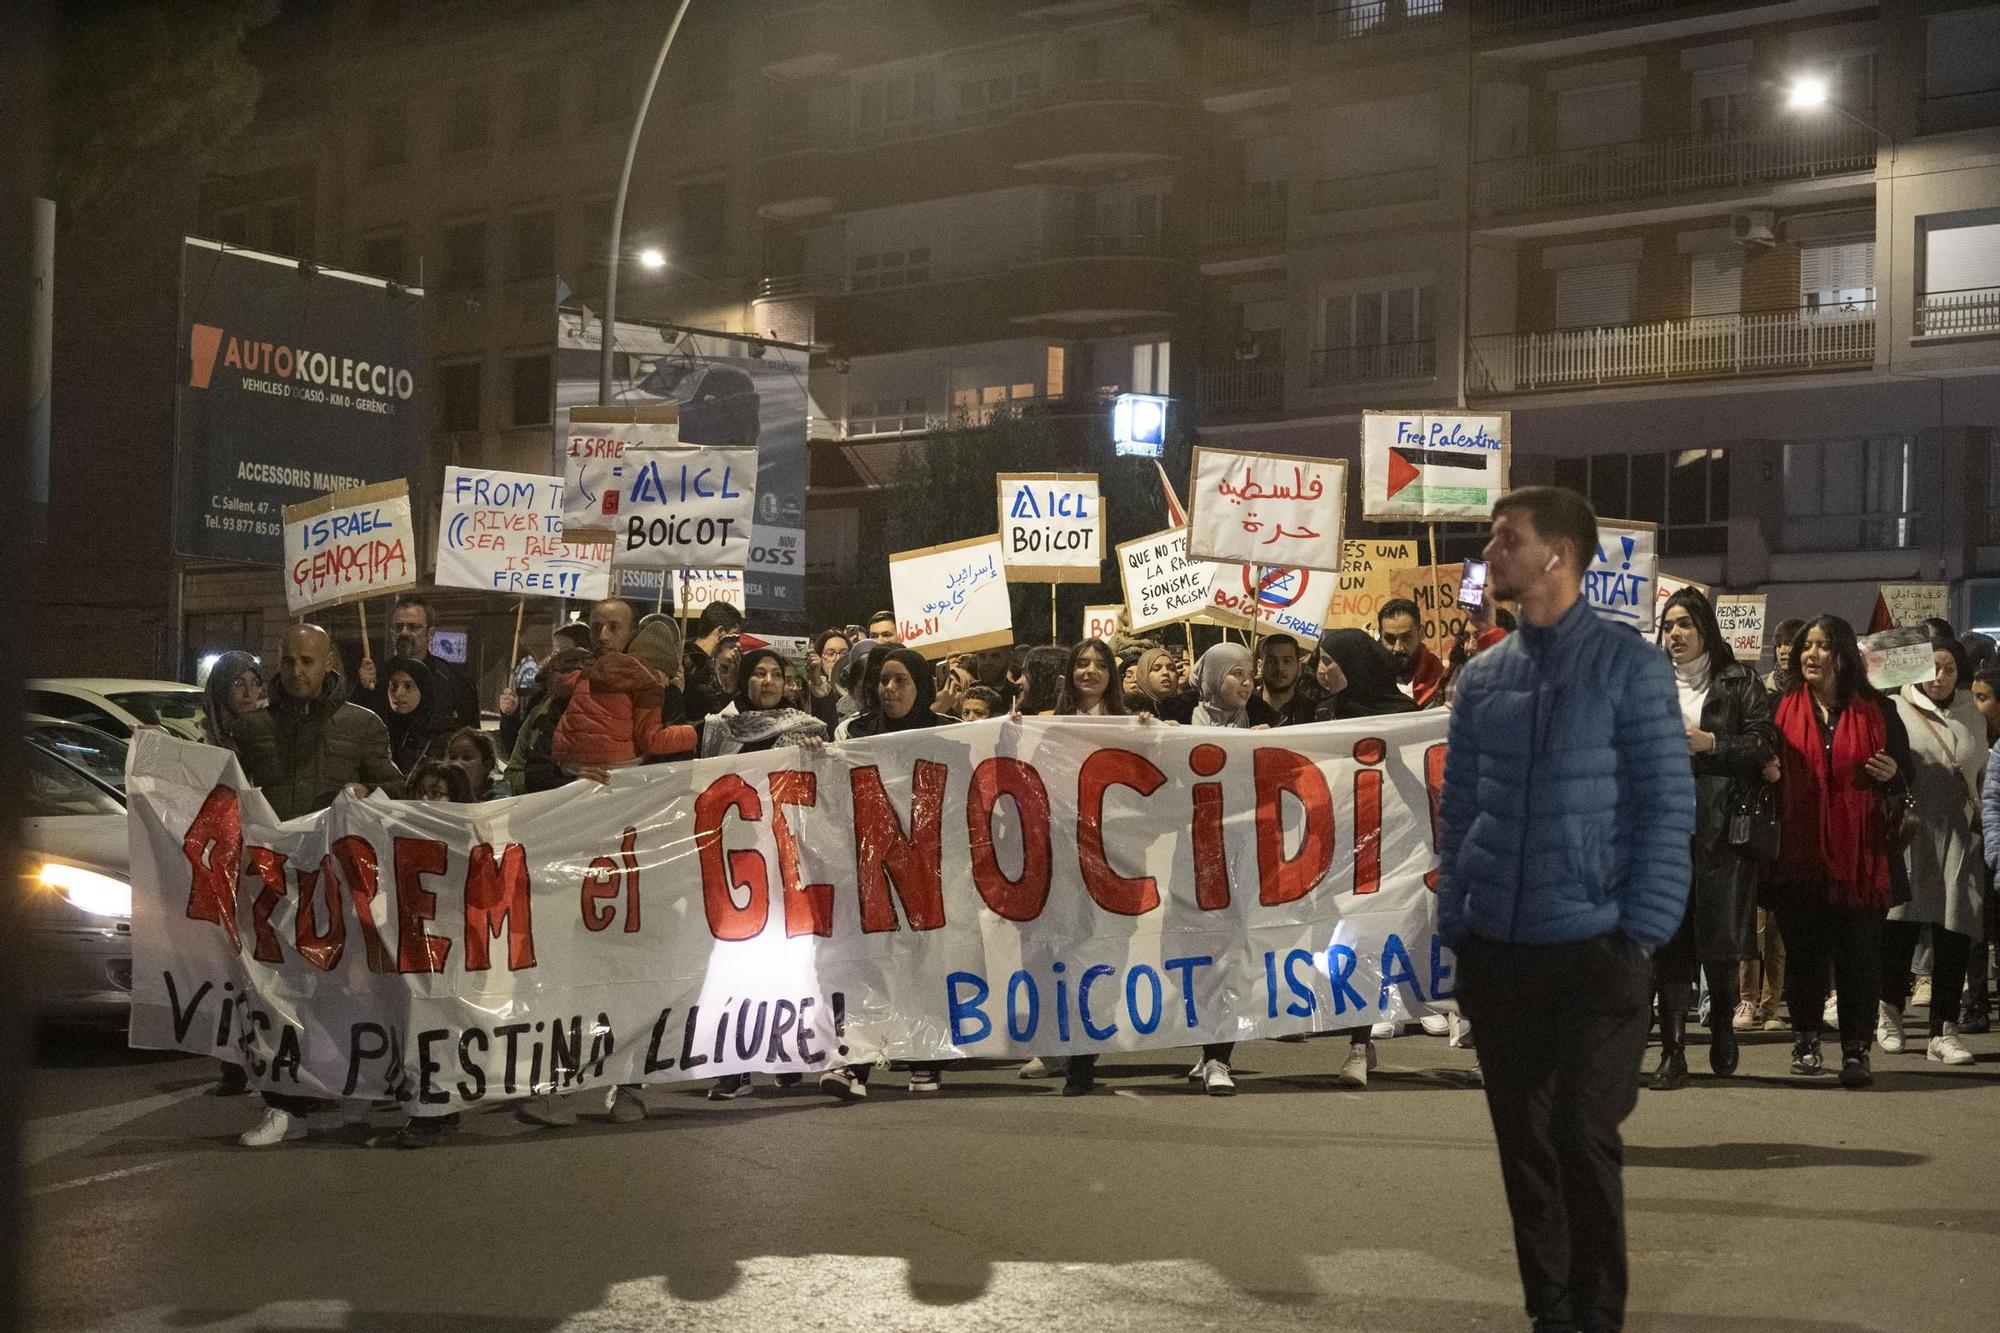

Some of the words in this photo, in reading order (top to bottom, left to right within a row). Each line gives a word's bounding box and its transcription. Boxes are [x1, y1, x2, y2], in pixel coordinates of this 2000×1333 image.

[224, 336, 414, 400] AUTOKOLECCIO
[242, 377, 283, 396] VEHICLES
[330, 393, 344, 406] KM
[1398, 422, 1426, 445] Free
[237, 461, 311, 489] ACCESSORIS
[1218, 466, 1323, 505] فلسطين
[456, 476, 535, 510] FROM
[222, 496, 256, 515] Sallent,
[257, 503, 269, 515] 47
[204, 514, 221, 529] Tel.
[222, 518, 234, 530] 93
[236, 519, 254, 533] 877
[255, 523, 267, 535] 85
[268, 525, 281, 537] 05
[302, 508, 393, 551] ISRAEL
[473, 511, 539, 533] RIVER
[1241, 512, 1321, 545] حرة
[464, 534, 506, 551] SEA
[778, 536, 796, 548] NOU
[1376, 543, 1409, 560] UNA
[505, 556, 531, 572] IS
[750, 547, 796, 566] OSS
[1128, 548, 1151, 569] QUE
[1154, 544, 1169, 560] NO
[1343, 560, 1373, 573] RRA
[946, 554, 998, 589] إسرائيل
[1147, 564, 1164, 580] LA
[493, 571, 582, 598] FREE!!
[1339, 576, 1366, 591] UN
[1584, 569, 1649, 608] RTAT
[922, 588, 966, 615] كابوس
[1331, 593, 1387, 616] ENOC
[1716, 605, 1747, 617] PEDRES
[1750, 605, 1757, 617] A
[1720, 619, 1736, 630] LES
[1738, 617, 1762, 630] MANS
[1734, 635, 1761, 650] ISRAEL
[580, 825, 641, 934] el
[1264, 933, 1450, 1019] ISRAE
